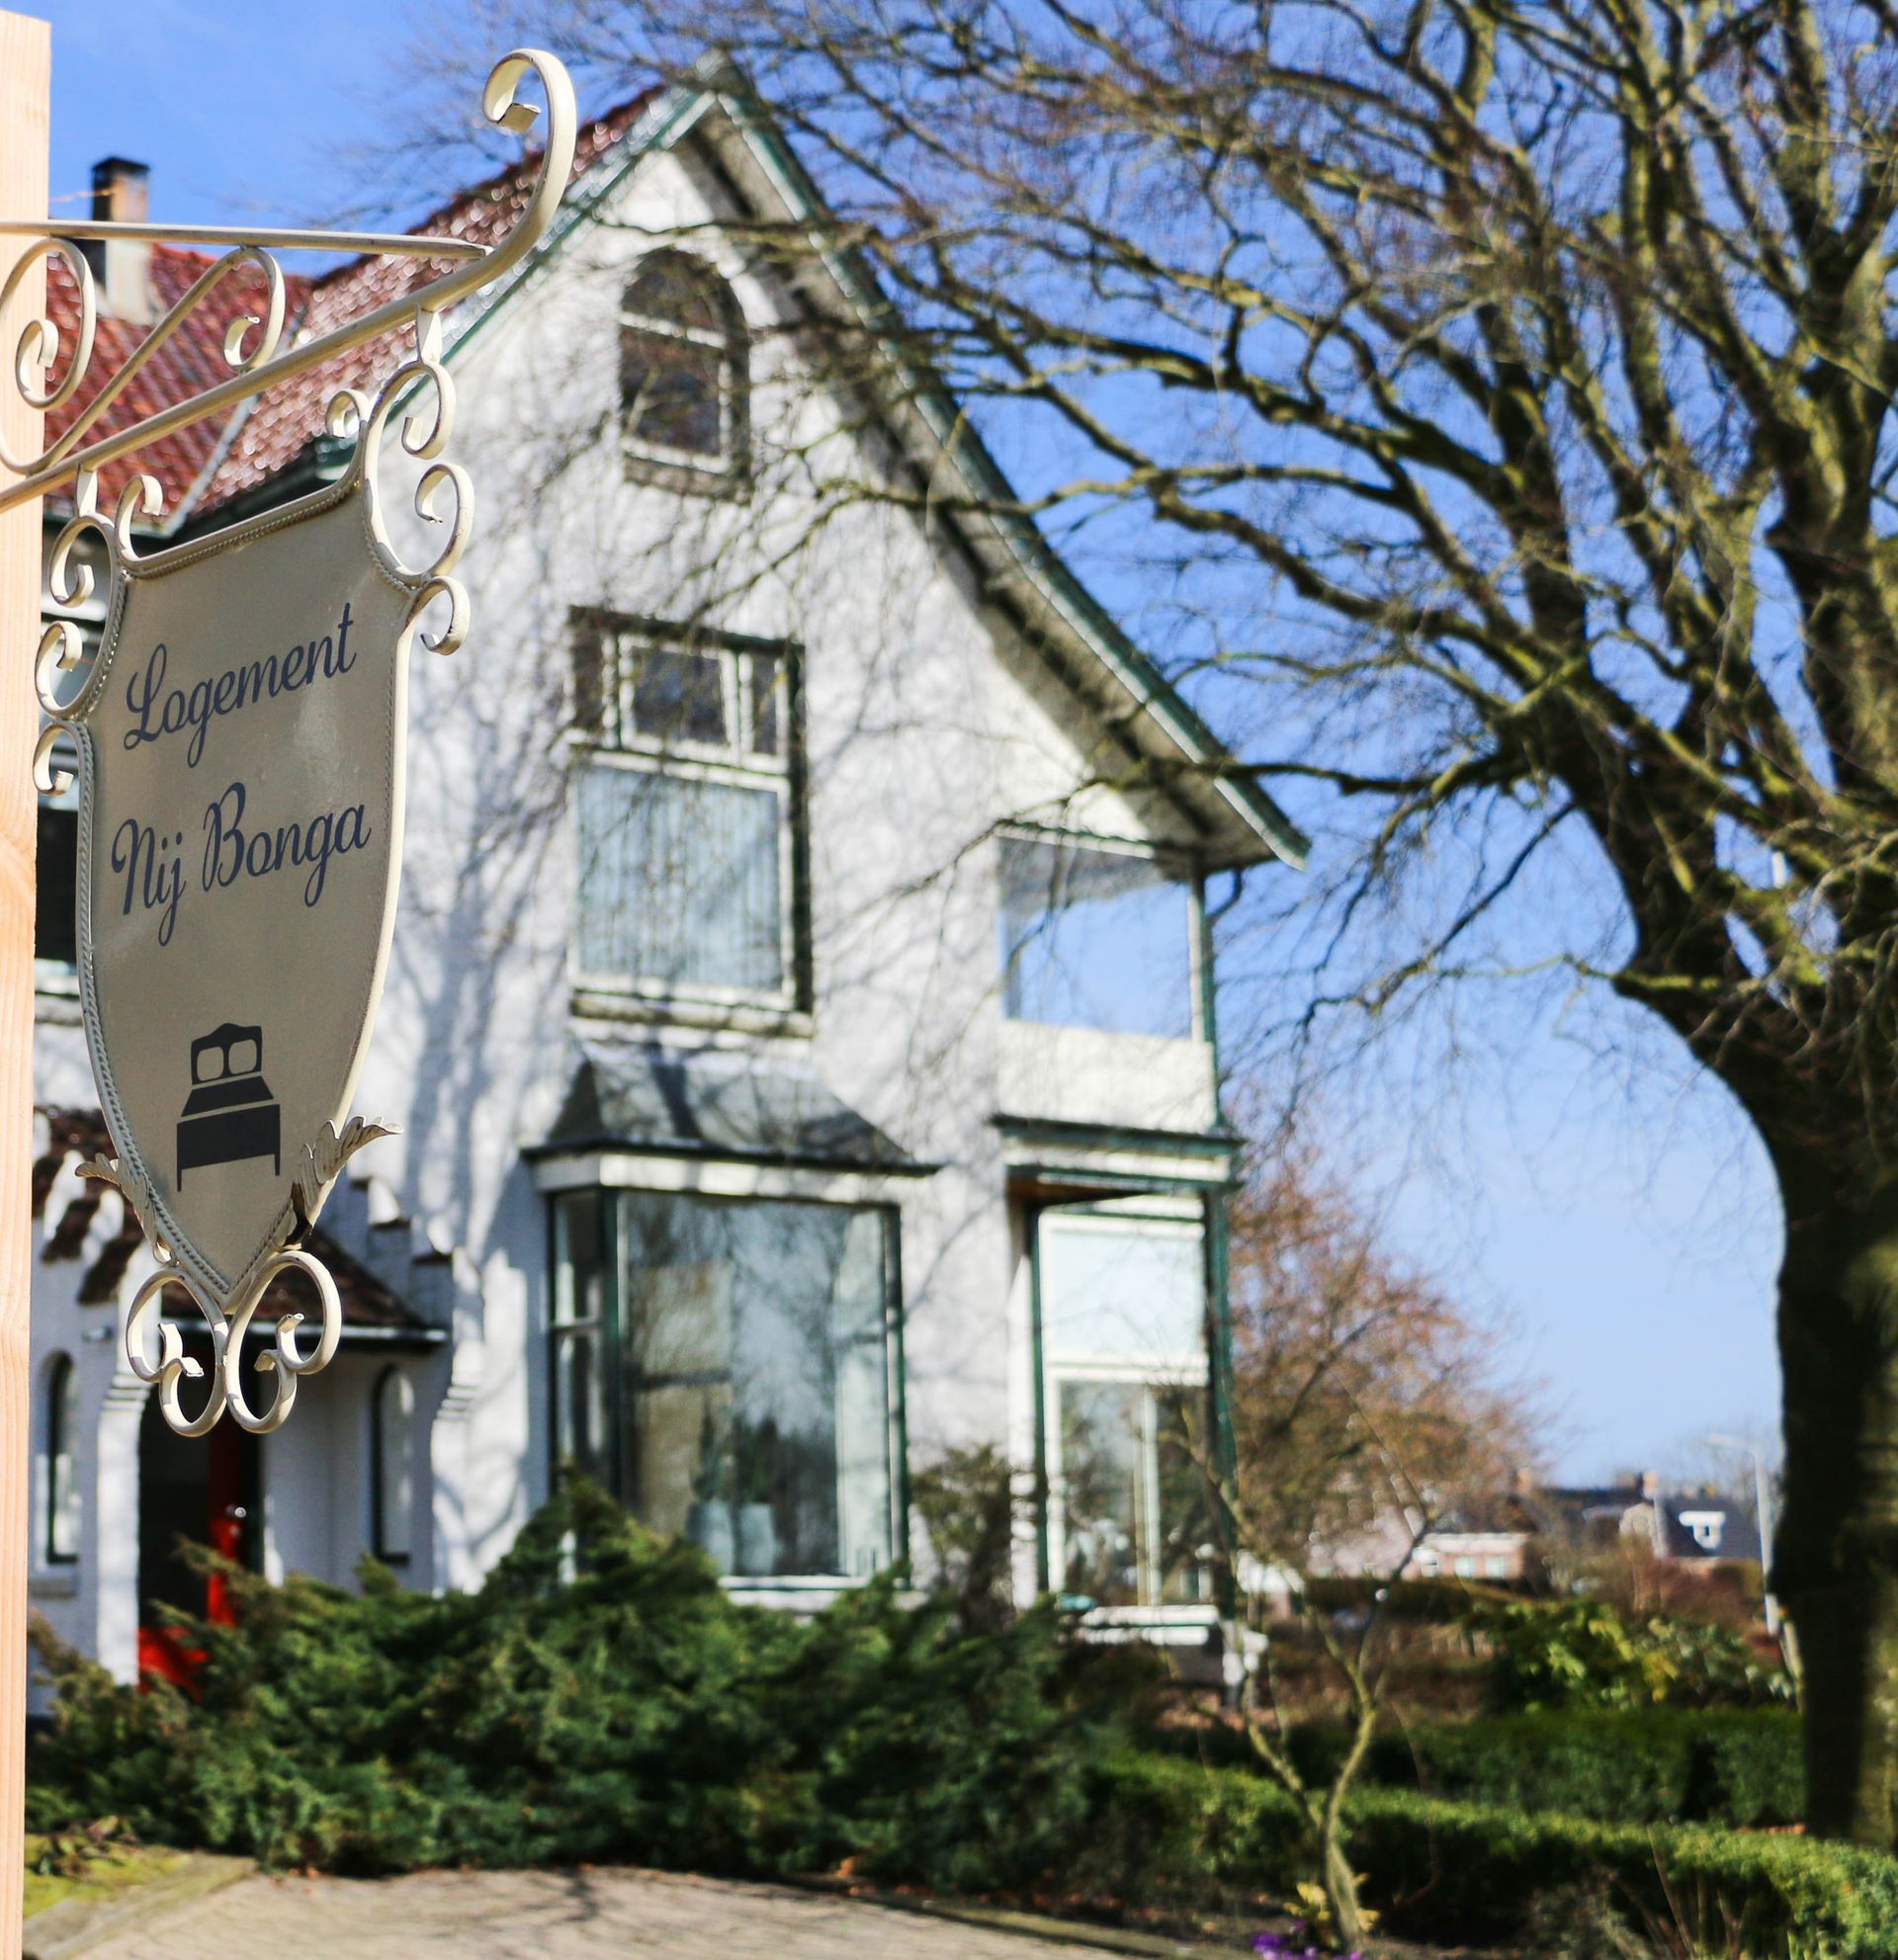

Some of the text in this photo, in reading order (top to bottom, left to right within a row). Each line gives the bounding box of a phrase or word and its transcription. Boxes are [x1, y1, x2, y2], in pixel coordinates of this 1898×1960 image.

[124, 602, 357, 768] Logement
[111, 782, 372, 947] Nij Bonga
